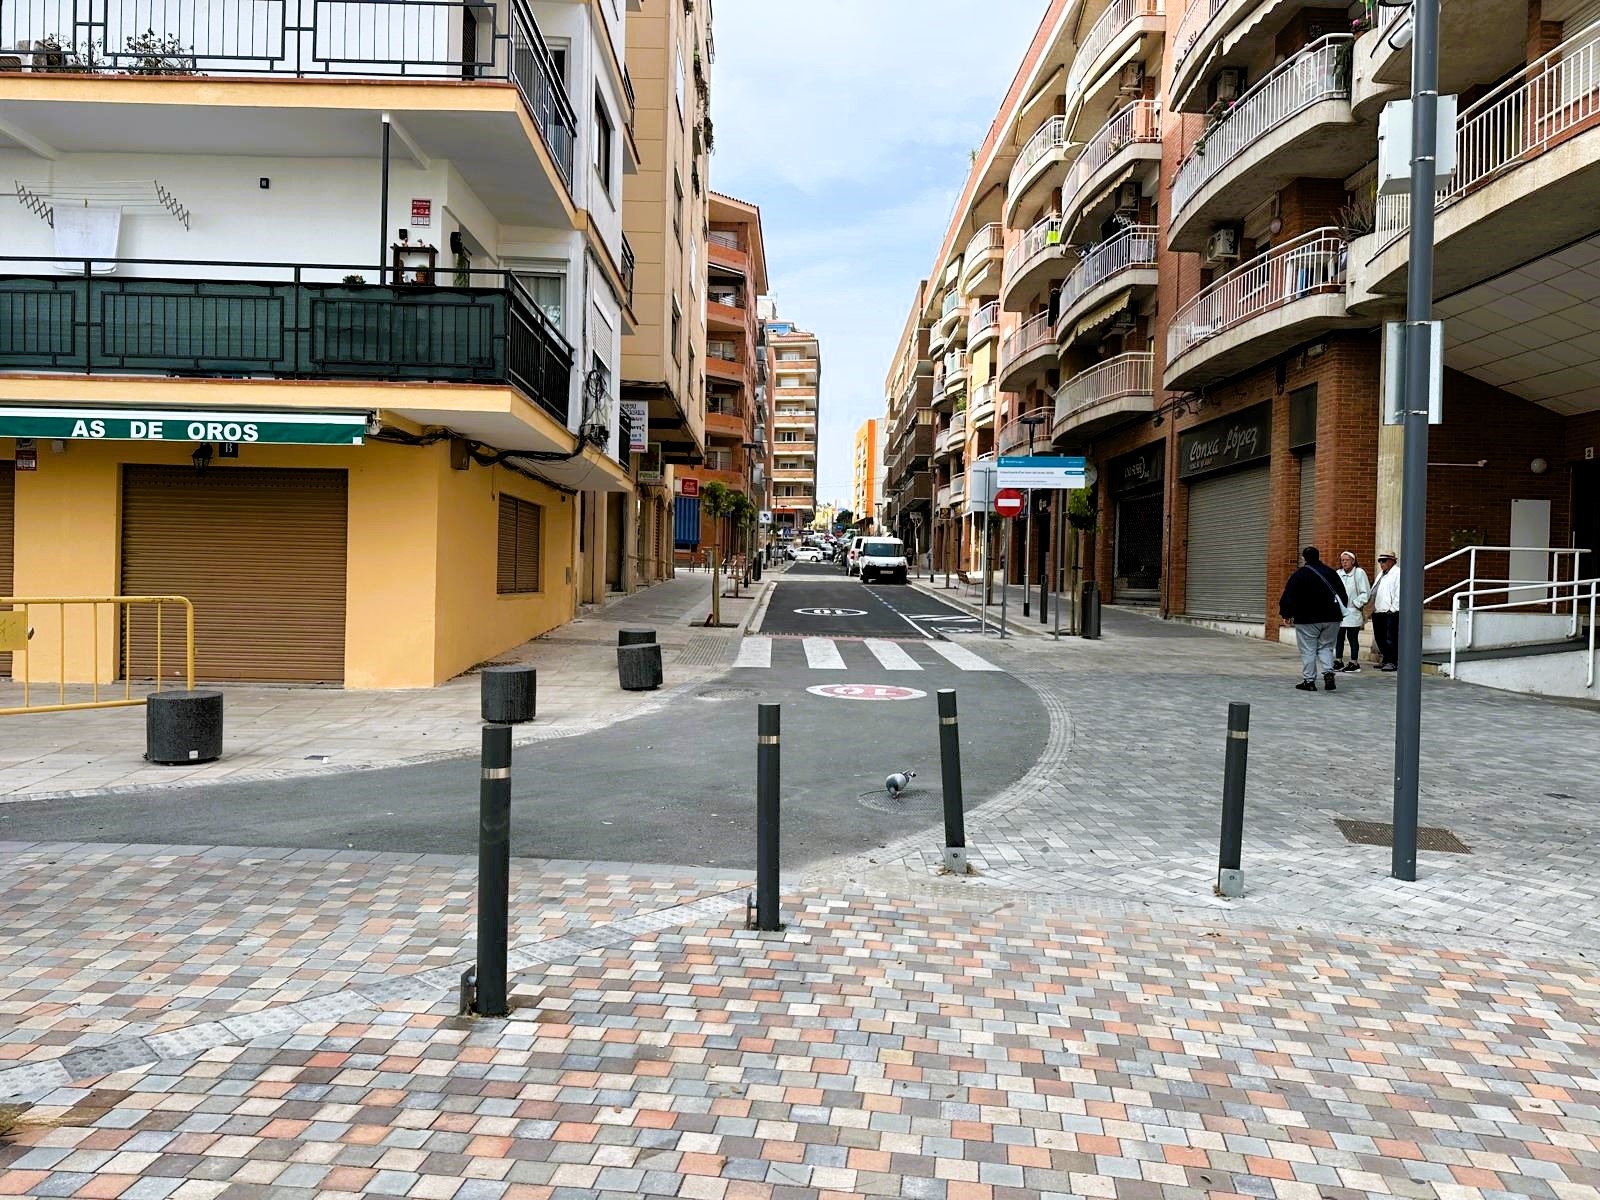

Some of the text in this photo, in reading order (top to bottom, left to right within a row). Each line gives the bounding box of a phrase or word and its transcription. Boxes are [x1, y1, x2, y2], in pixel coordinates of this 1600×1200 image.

[71, 420, 259, 442] AS DE OROS
[1190, 425, 1257, 461] Conxa López
